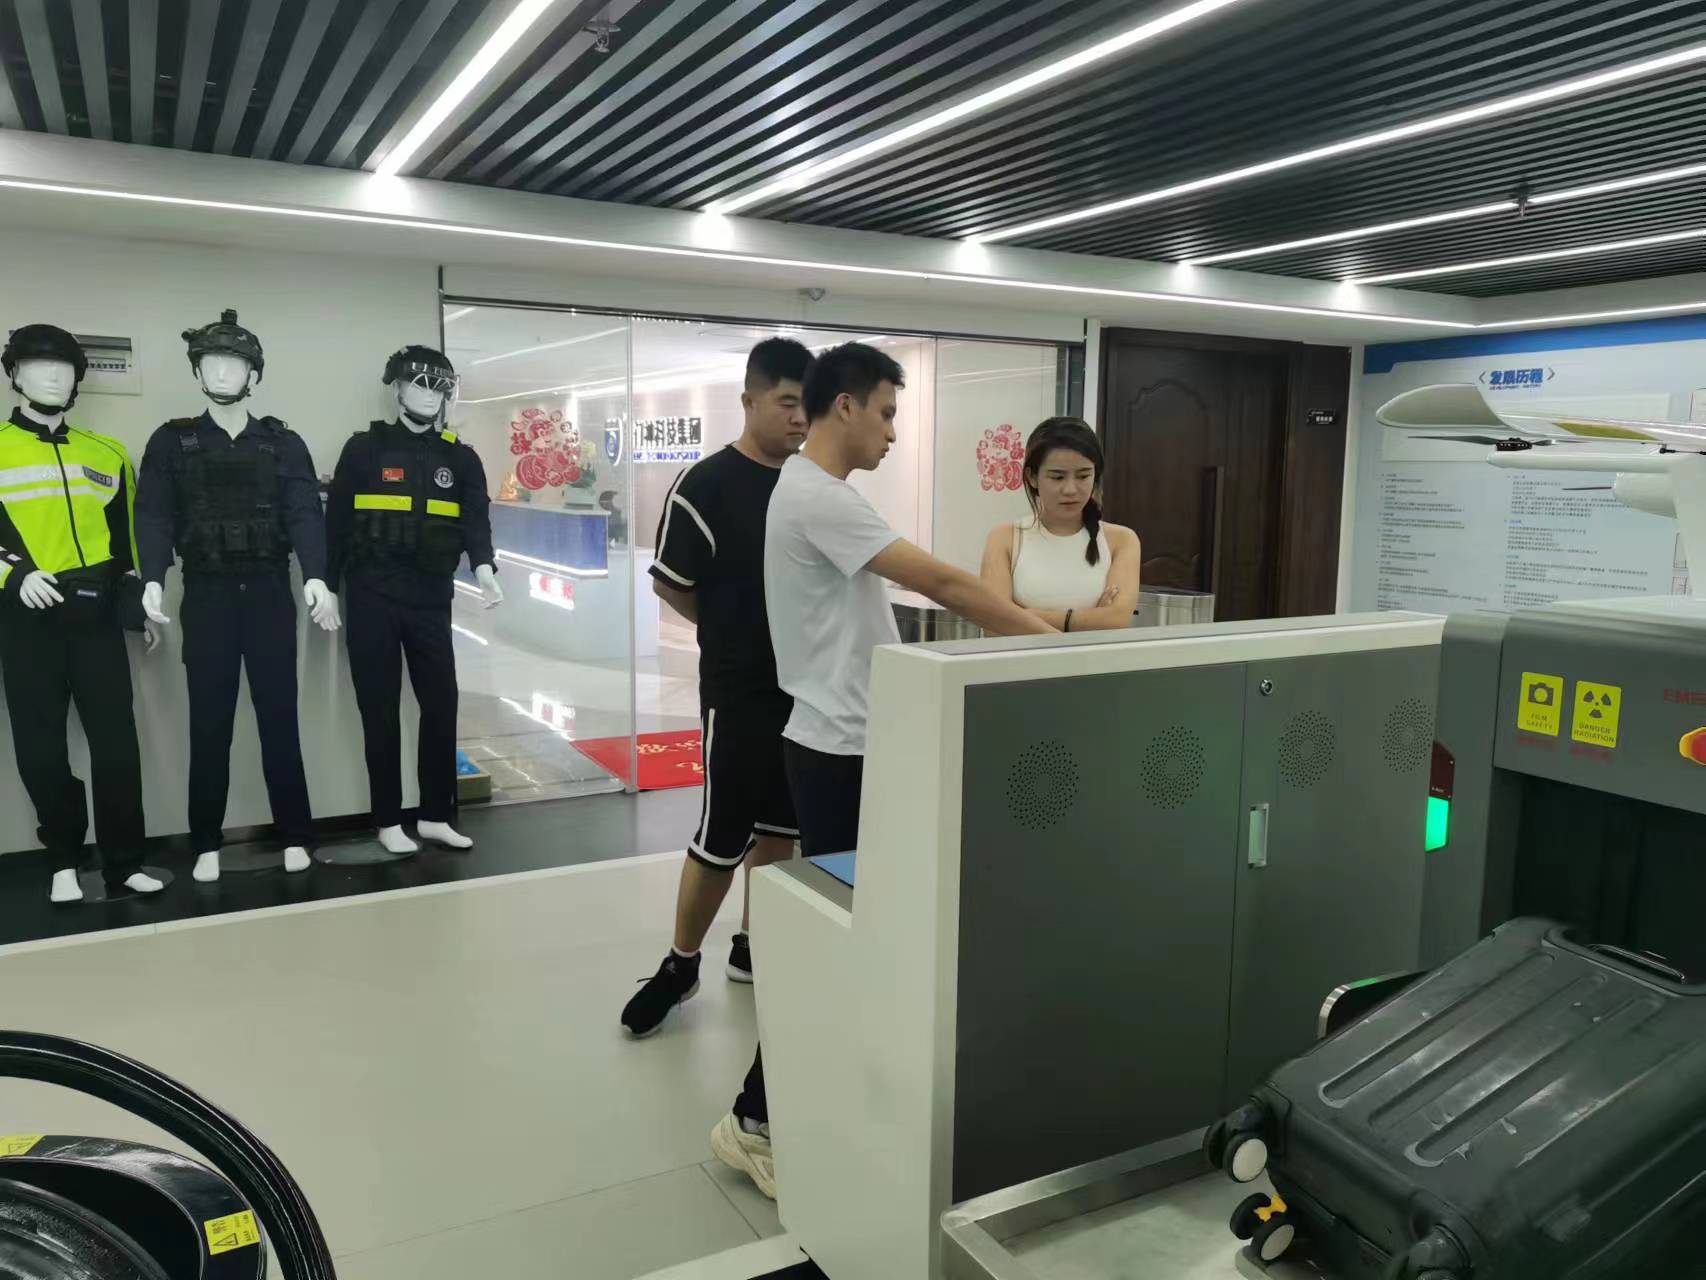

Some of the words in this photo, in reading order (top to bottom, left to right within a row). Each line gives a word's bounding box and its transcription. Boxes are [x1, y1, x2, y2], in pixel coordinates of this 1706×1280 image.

[623, 416, 702, 449] 门神科技集团
[1578, 722, 1611, 734] DANGER
[1574, 729, 1615, 743] RADIATION
